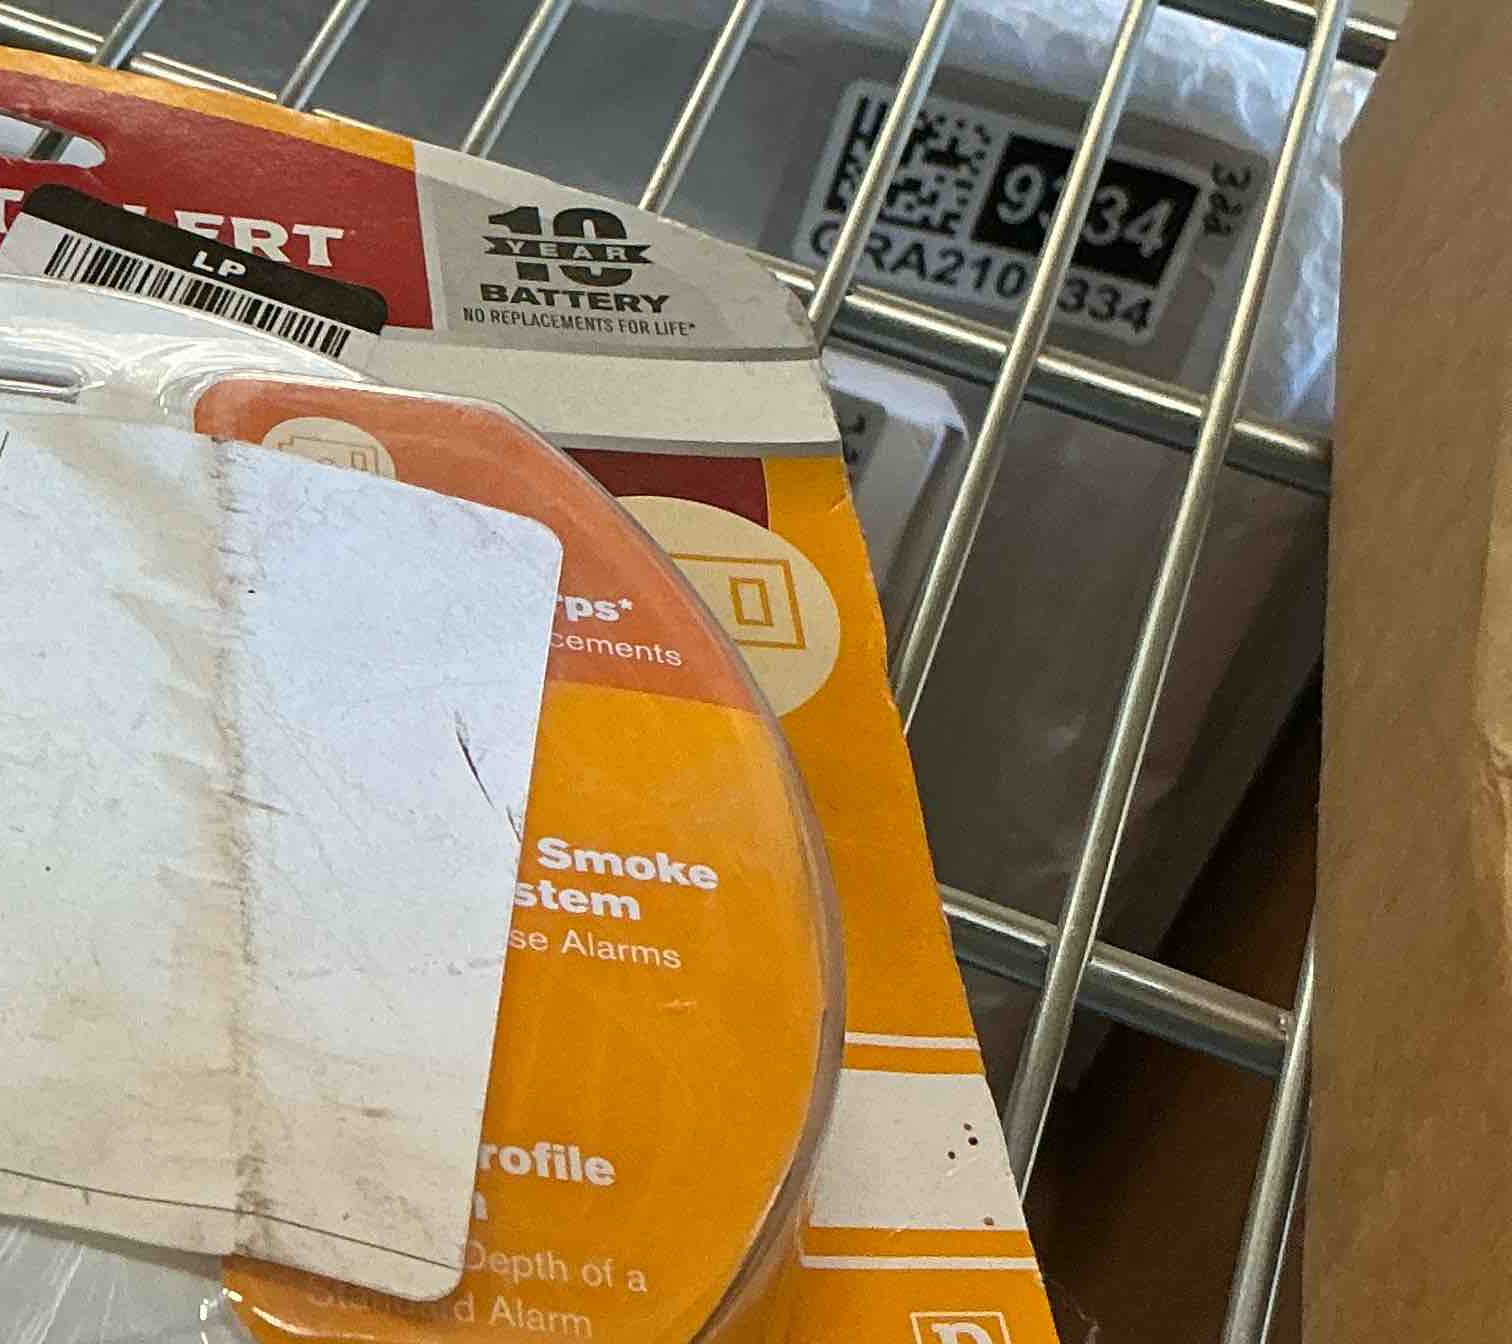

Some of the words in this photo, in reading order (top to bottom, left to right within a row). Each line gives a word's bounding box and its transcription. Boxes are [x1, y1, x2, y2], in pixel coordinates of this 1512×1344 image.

[996, 163, 1177, 258] 934
[192, 251, 247, 277] LP
[506, 239, 630, 262] YEAR
[810, 220, 1154, 334] RA210334
[480, 283, 671, 314] BATTERY
[463, 307, 486, 323] NO
[491, 309, 614, 334] REPLACEMENTS
[619, 319, 650, 336] FOR
[538, 836, 719, 890] Smoke
[560, 929, 682, 970] Alarms
[581, 1257, 616, 1288] of
[626, 1268, 649, 1293] a
[489, 1294, 593, 1339] Alarm
